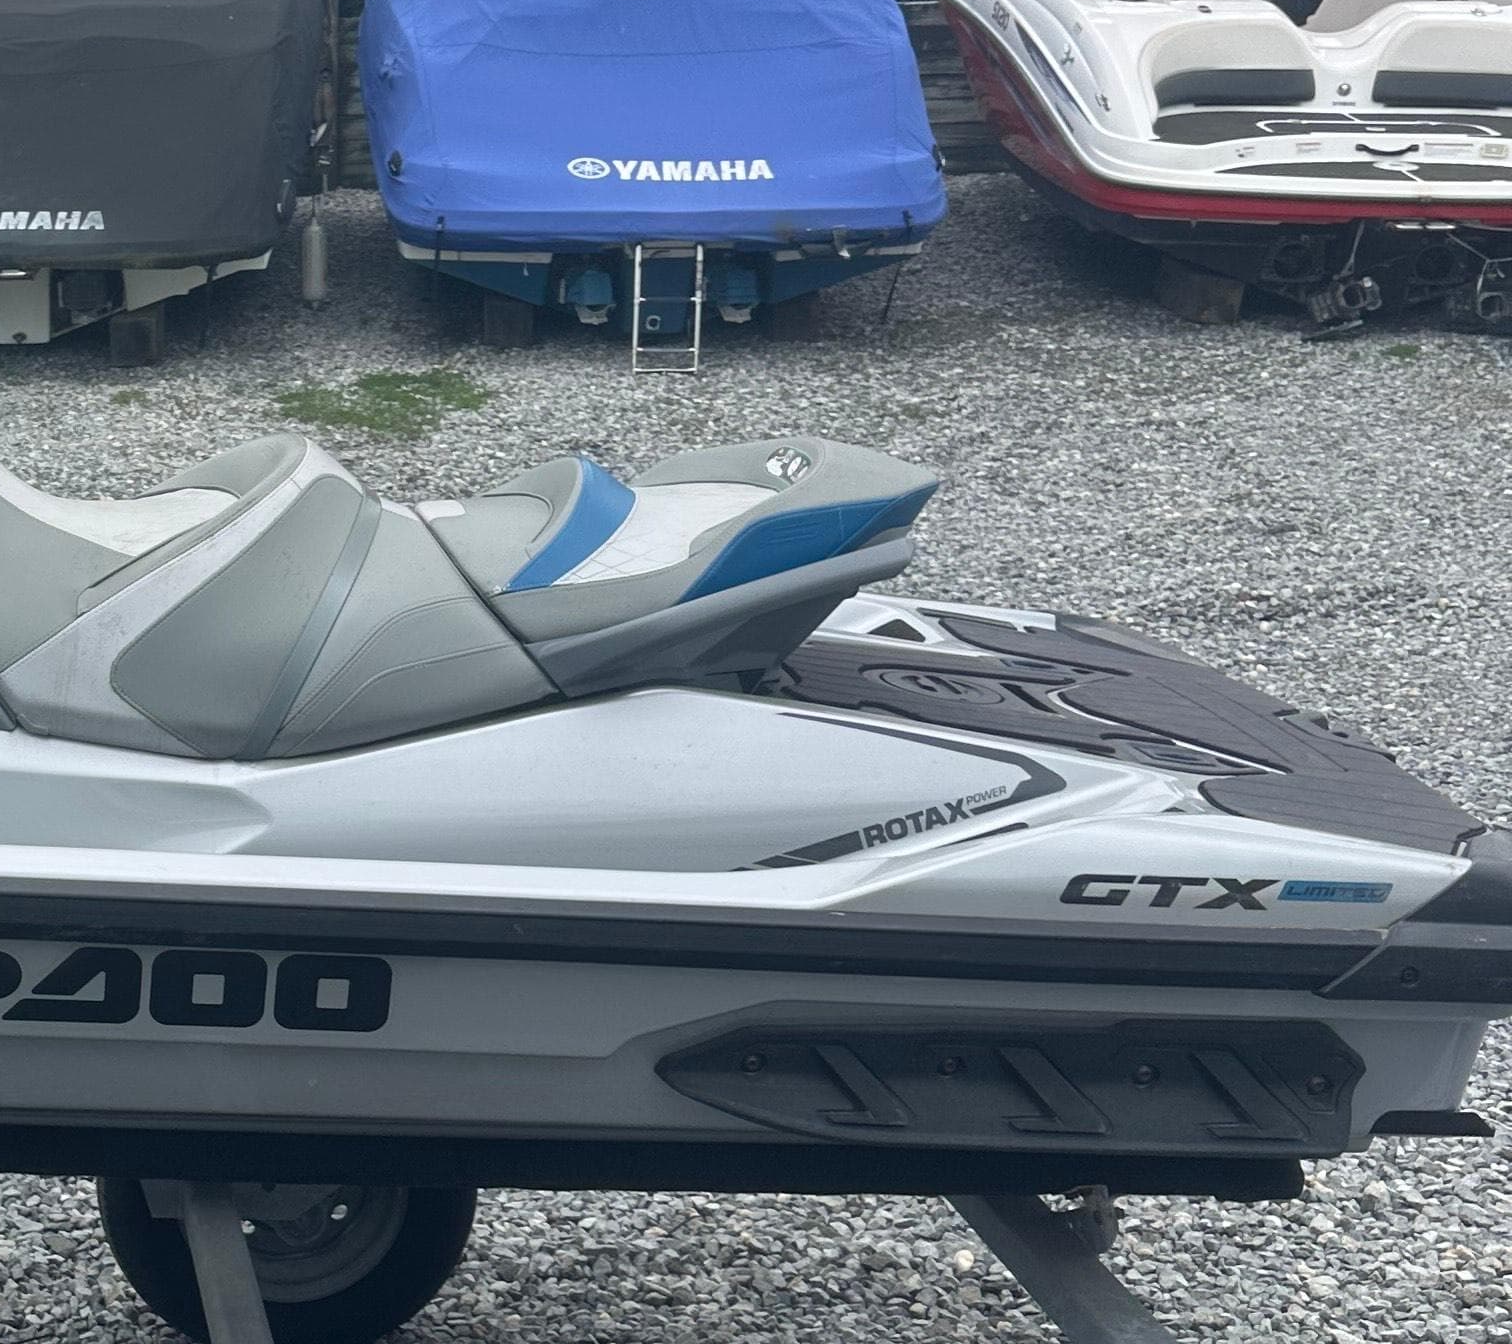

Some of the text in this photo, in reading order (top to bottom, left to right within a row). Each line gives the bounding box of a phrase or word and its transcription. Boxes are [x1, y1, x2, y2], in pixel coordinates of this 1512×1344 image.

[612, 159, 774, 181] YAMAHA
[863, 785, 1007, 848] ROTAX POWER
[1059, 874, 1281, 911] GTX
